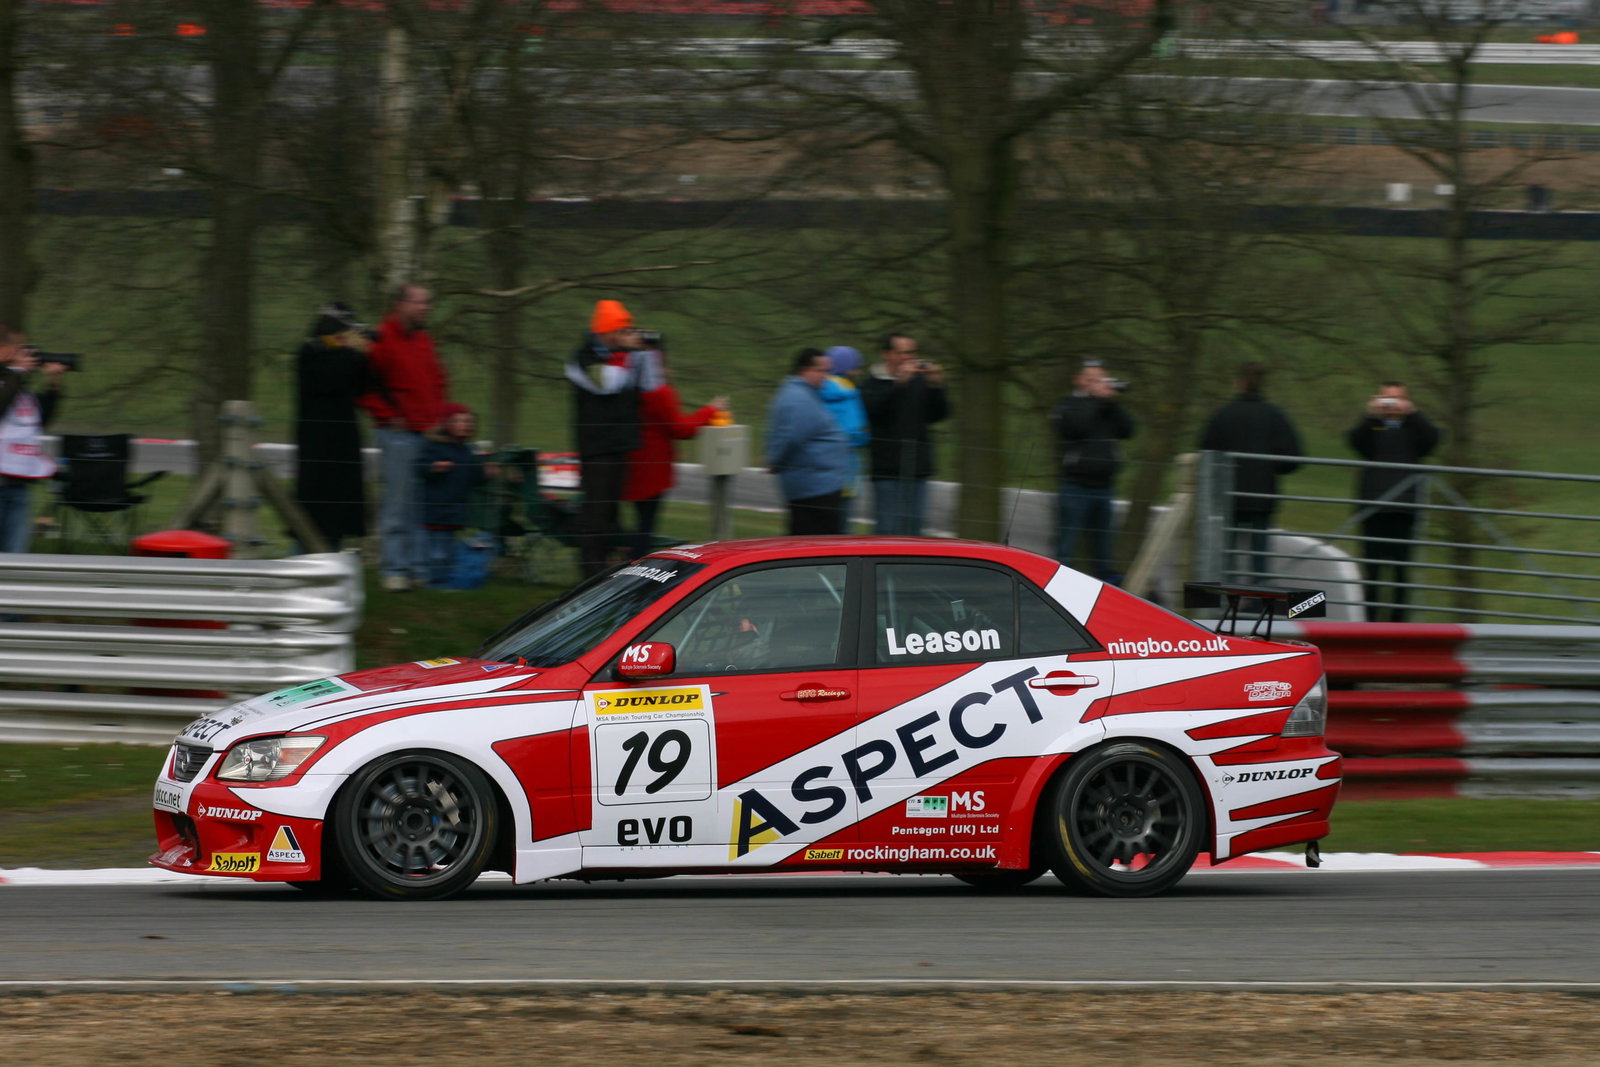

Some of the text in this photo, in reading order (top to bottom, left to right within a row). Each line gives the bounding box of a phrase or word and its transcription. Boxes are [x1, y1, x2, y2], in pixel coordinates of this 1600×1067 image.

[1290, 592, 1325, 617] ASPECT
[886, 628, 1000, 655] Leason
[1108, 636, 1231, 657] ningbo.co.uk
[622, 644, 652, 662] MS
[614, 693, 699, 707] DUNLOP
[818, 689, 841, 698] Racing
[631, 713, 652, 721] Touring
[666, 711, 705, 719] Championship
[614, 729, 692, 796] 19
[729, 666, 1044, 861] ASPECT
[1236, 768, 1313, 783] DUNLOP
[951, 791, 985, 811] MS
[206, 806, 262, 820] DUNLOP
[617, 815, 692, 846] evo
[892, 824, 999, 836] Pentagon (UK) Ltd
[269, 850, 301, 859] ASPECT
[807, 850, 841, 859] Sabelt
[847, 845, 996, 862] rockingham.co.uk
[211, 854, 258, 872] Sabelt
